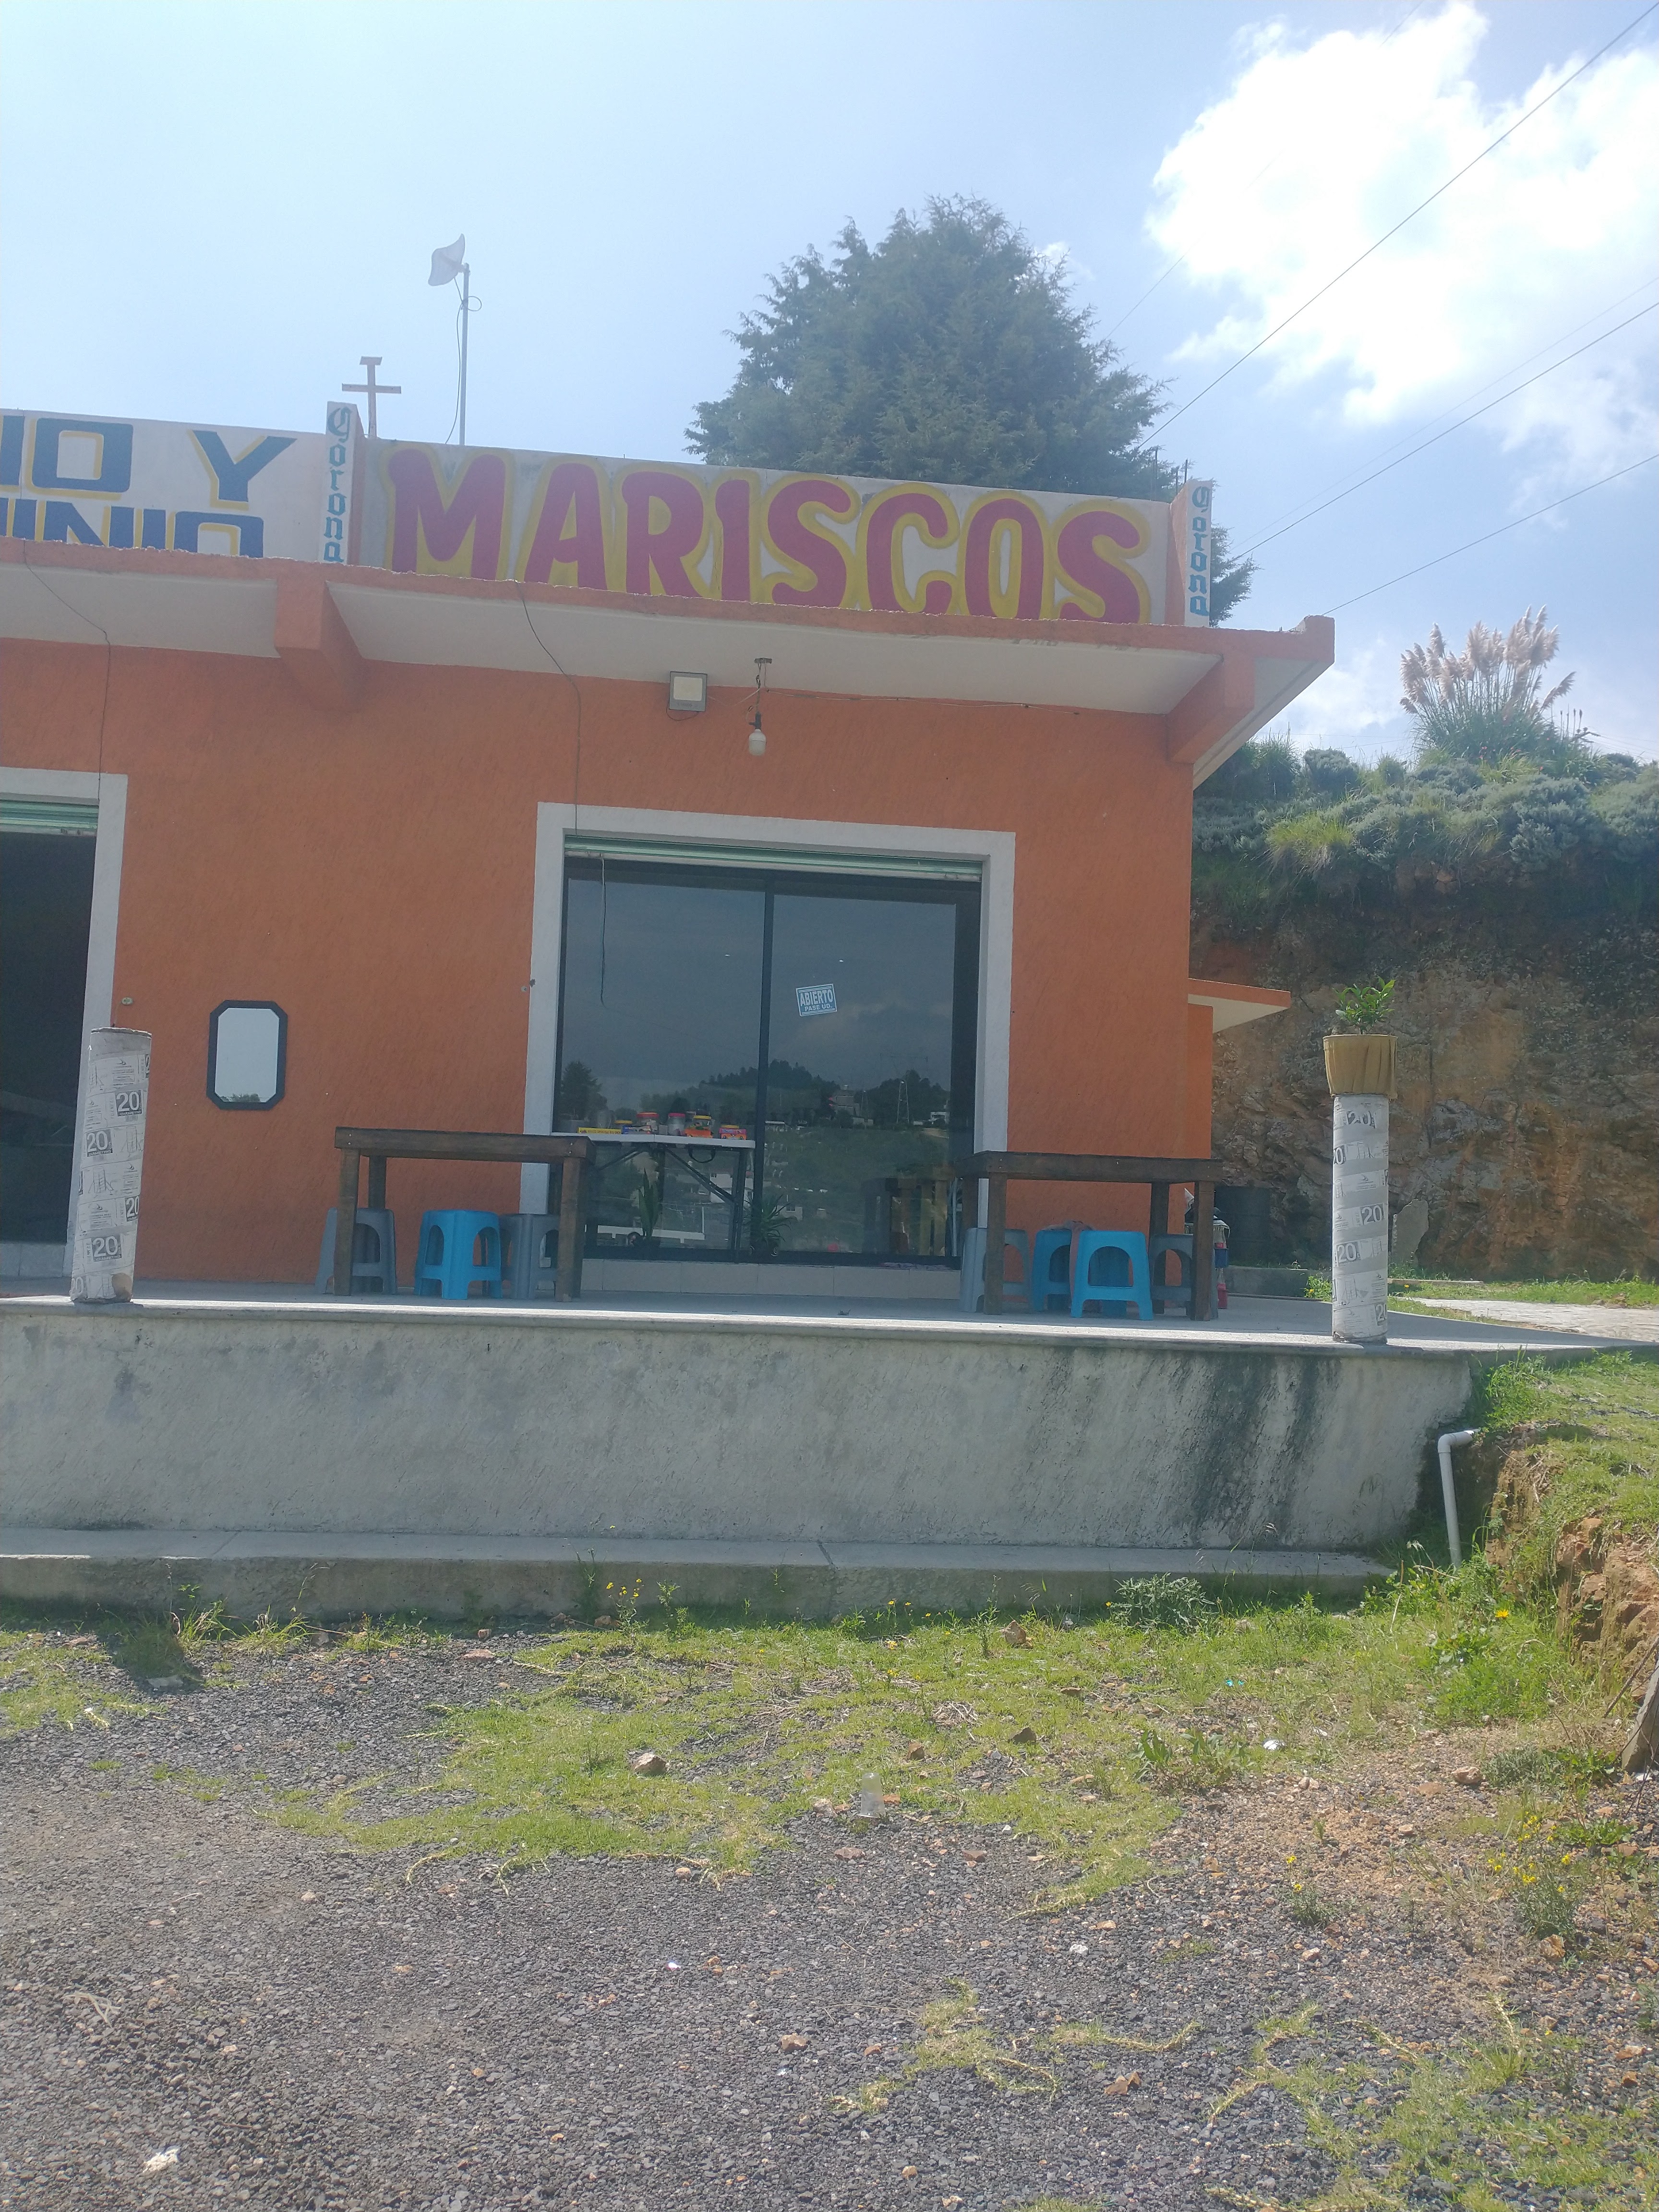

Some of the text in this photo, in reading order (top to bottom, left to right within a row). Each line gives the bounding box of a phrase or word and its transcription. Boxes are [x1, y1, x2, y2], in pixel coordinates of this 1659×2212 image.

[189, 430, 298, 507] Y
[324, 407, 352, 563] Corona
[0, 497, 264, 558] INIO
[386, 445, 1142, 623] MARISCOS
[1188, 486, 1210, 616] Corona
[800, 989, 833, 1006] ABIERTO
[116, 1091, 140, 1112] 20
[87, 1130, 108, 1152] 20
[126, 1195, 139, 1217] 20
[1361, 1205, 1382, 1225] 20
[92, 1236, 118, 1257] 20
[1337, 1242, 1357, 1263] 20
